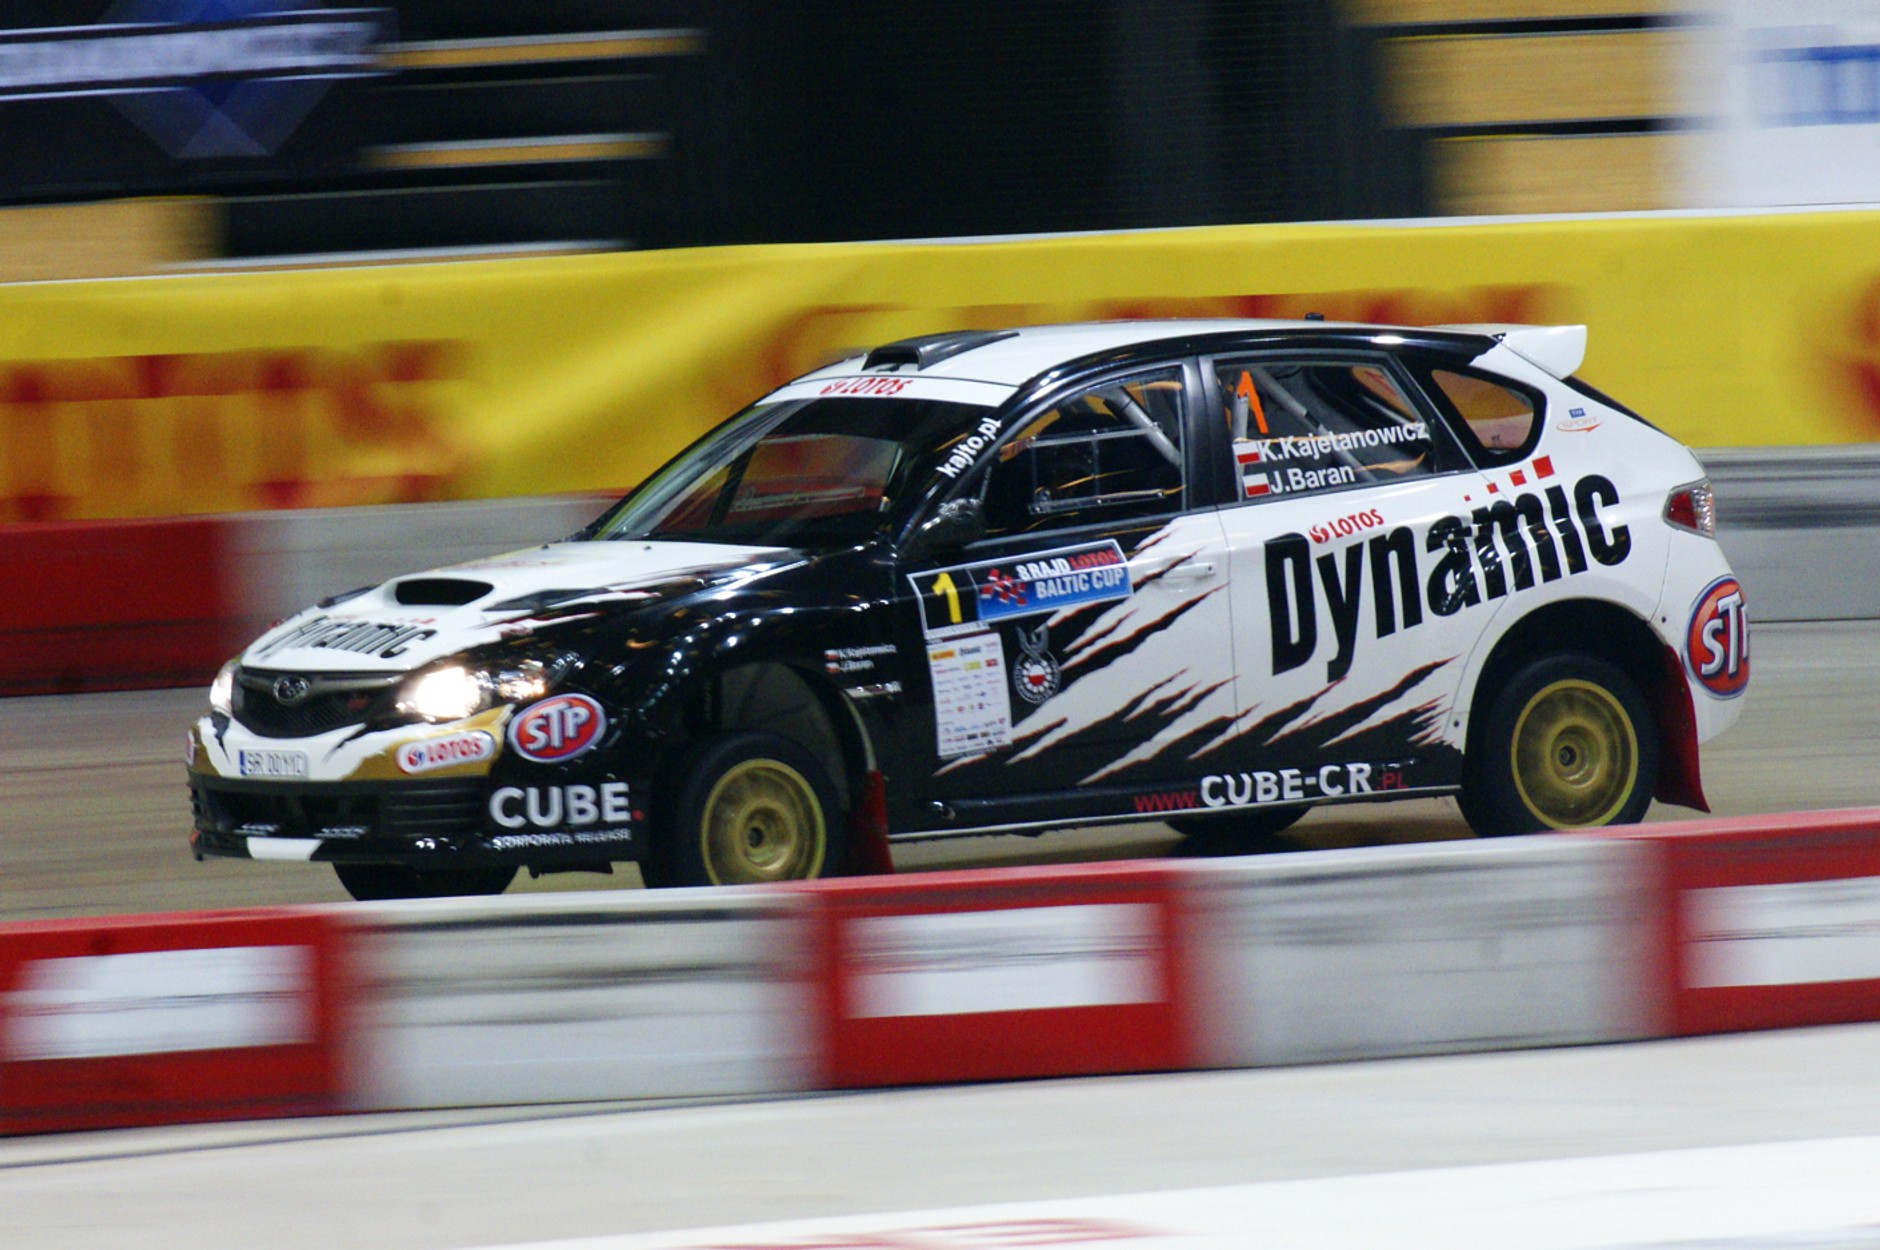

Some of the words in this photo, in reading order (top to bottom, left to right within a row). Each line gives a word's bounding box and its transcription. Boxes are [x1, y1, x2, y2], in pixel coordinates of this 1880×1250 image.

[842, 376, 914, 396] LOTOS
[935, 417, 1002, 479] kajto.pl
[1258, 422, 1431, 463] K.Kajetanowicz
[1270, 464, 1356, 495] J.Baran
[1328, 508, 1384, 538] LOTOS
[1067, 549, 1120, 570] LOTOS
[1035, 573, 1090, 599] BALTIC
[1091, 567, 1125, 590] CUP
[1264, 474, 1632, 683] Dynamic
[931, 571, 963, 624] 1
[525, 701, 591, 751] STP
[425, 738, 484, 764] LOTOS
